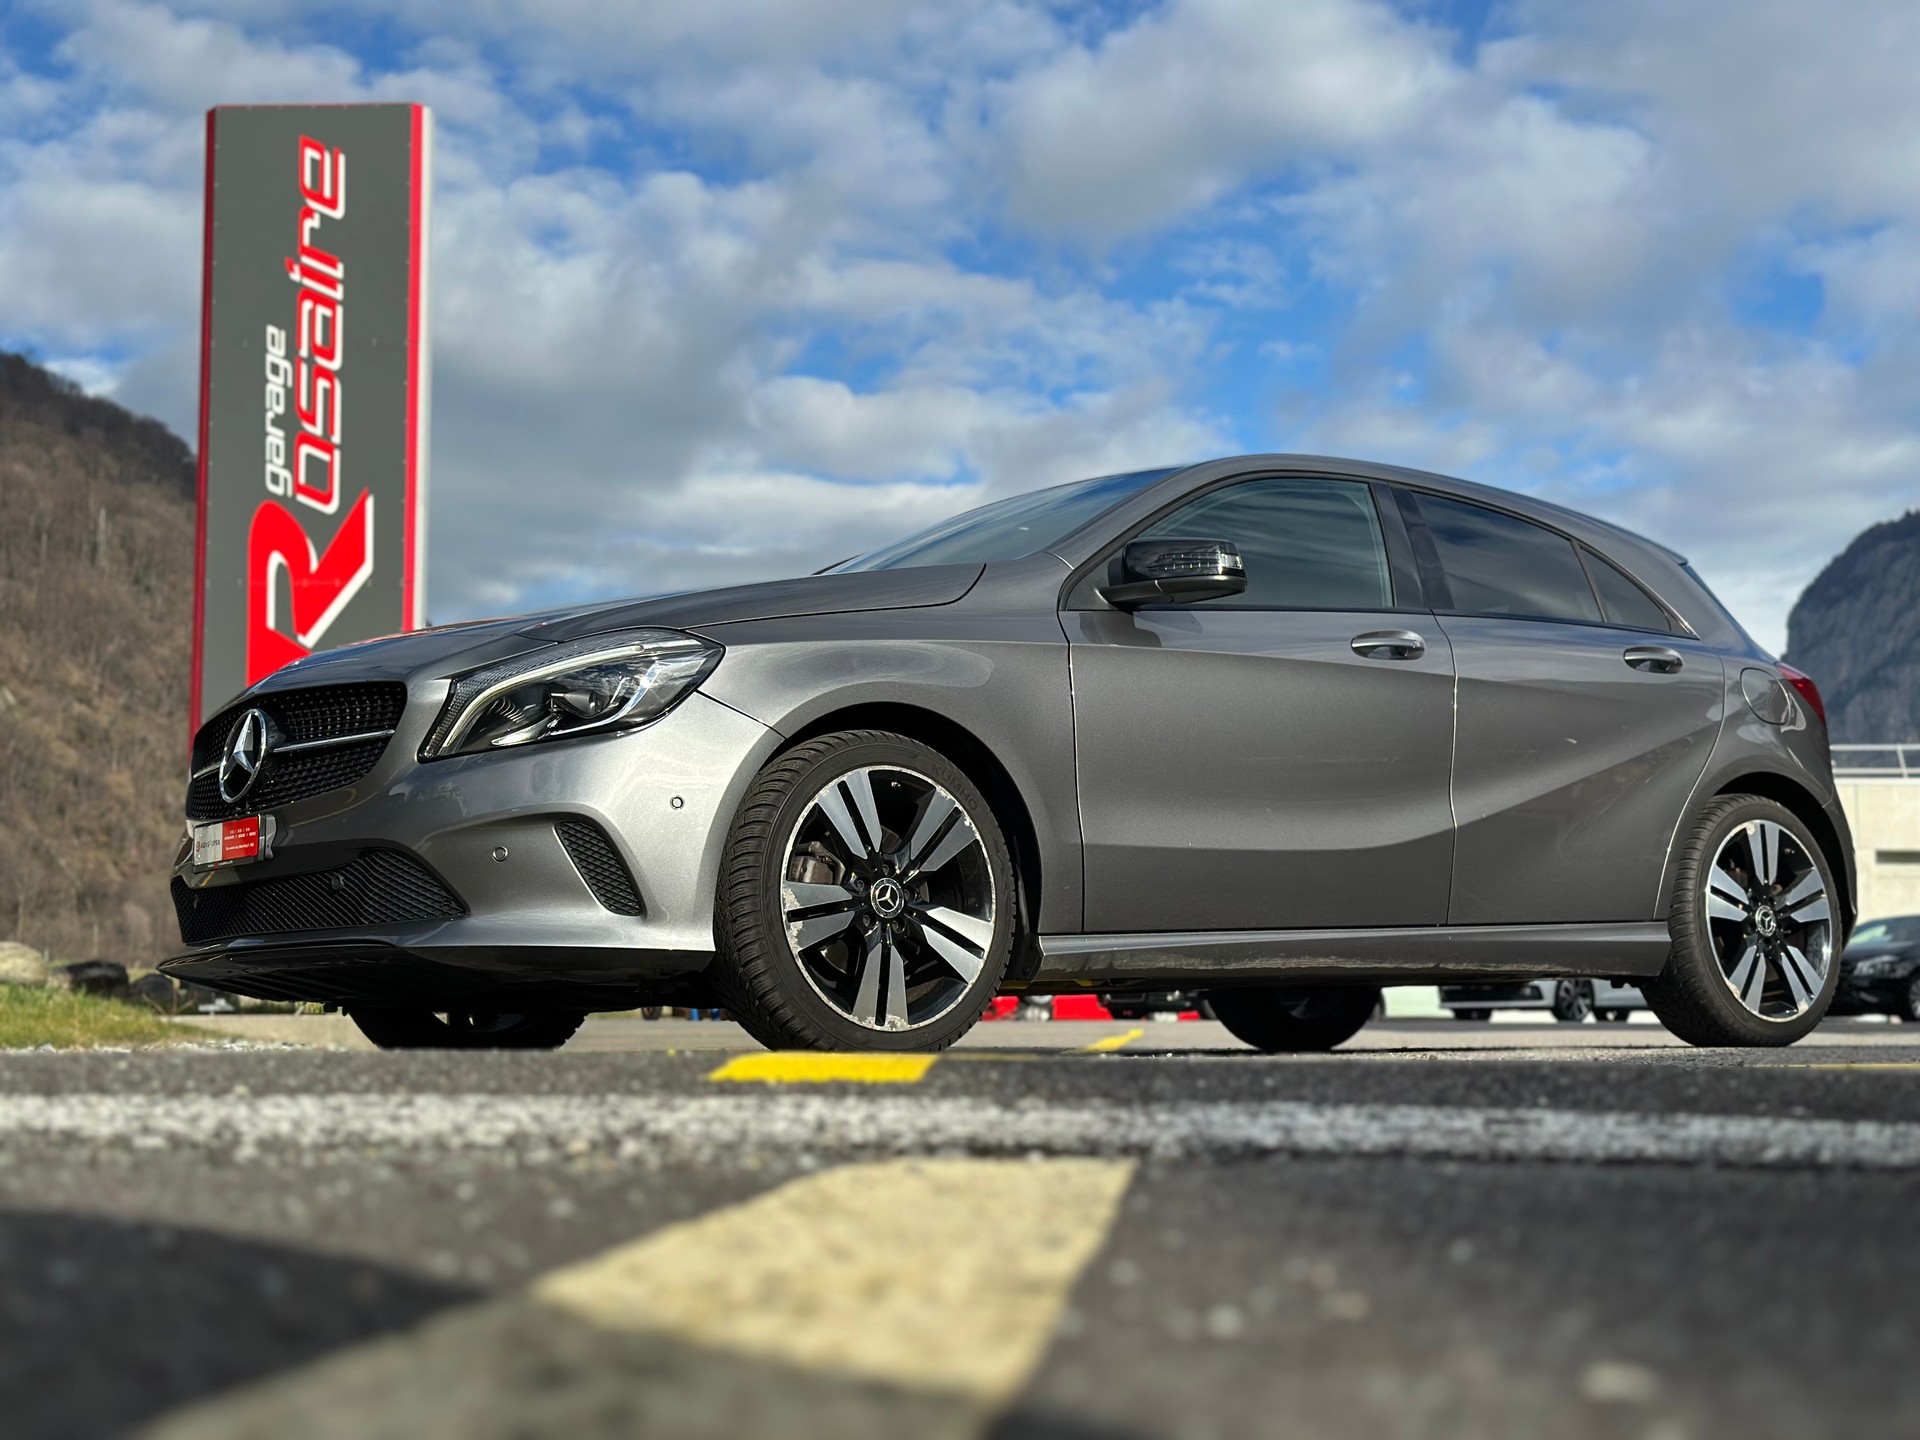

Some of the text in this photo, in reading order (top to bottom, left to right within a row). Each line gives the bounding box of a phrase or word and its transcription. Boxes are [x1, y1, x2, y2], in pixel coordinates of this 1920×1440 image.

[247, 134, 373, 687] Rosaire
[265, 325, 292, 497] garage
[932, 764, 977, 811] KUMHO
